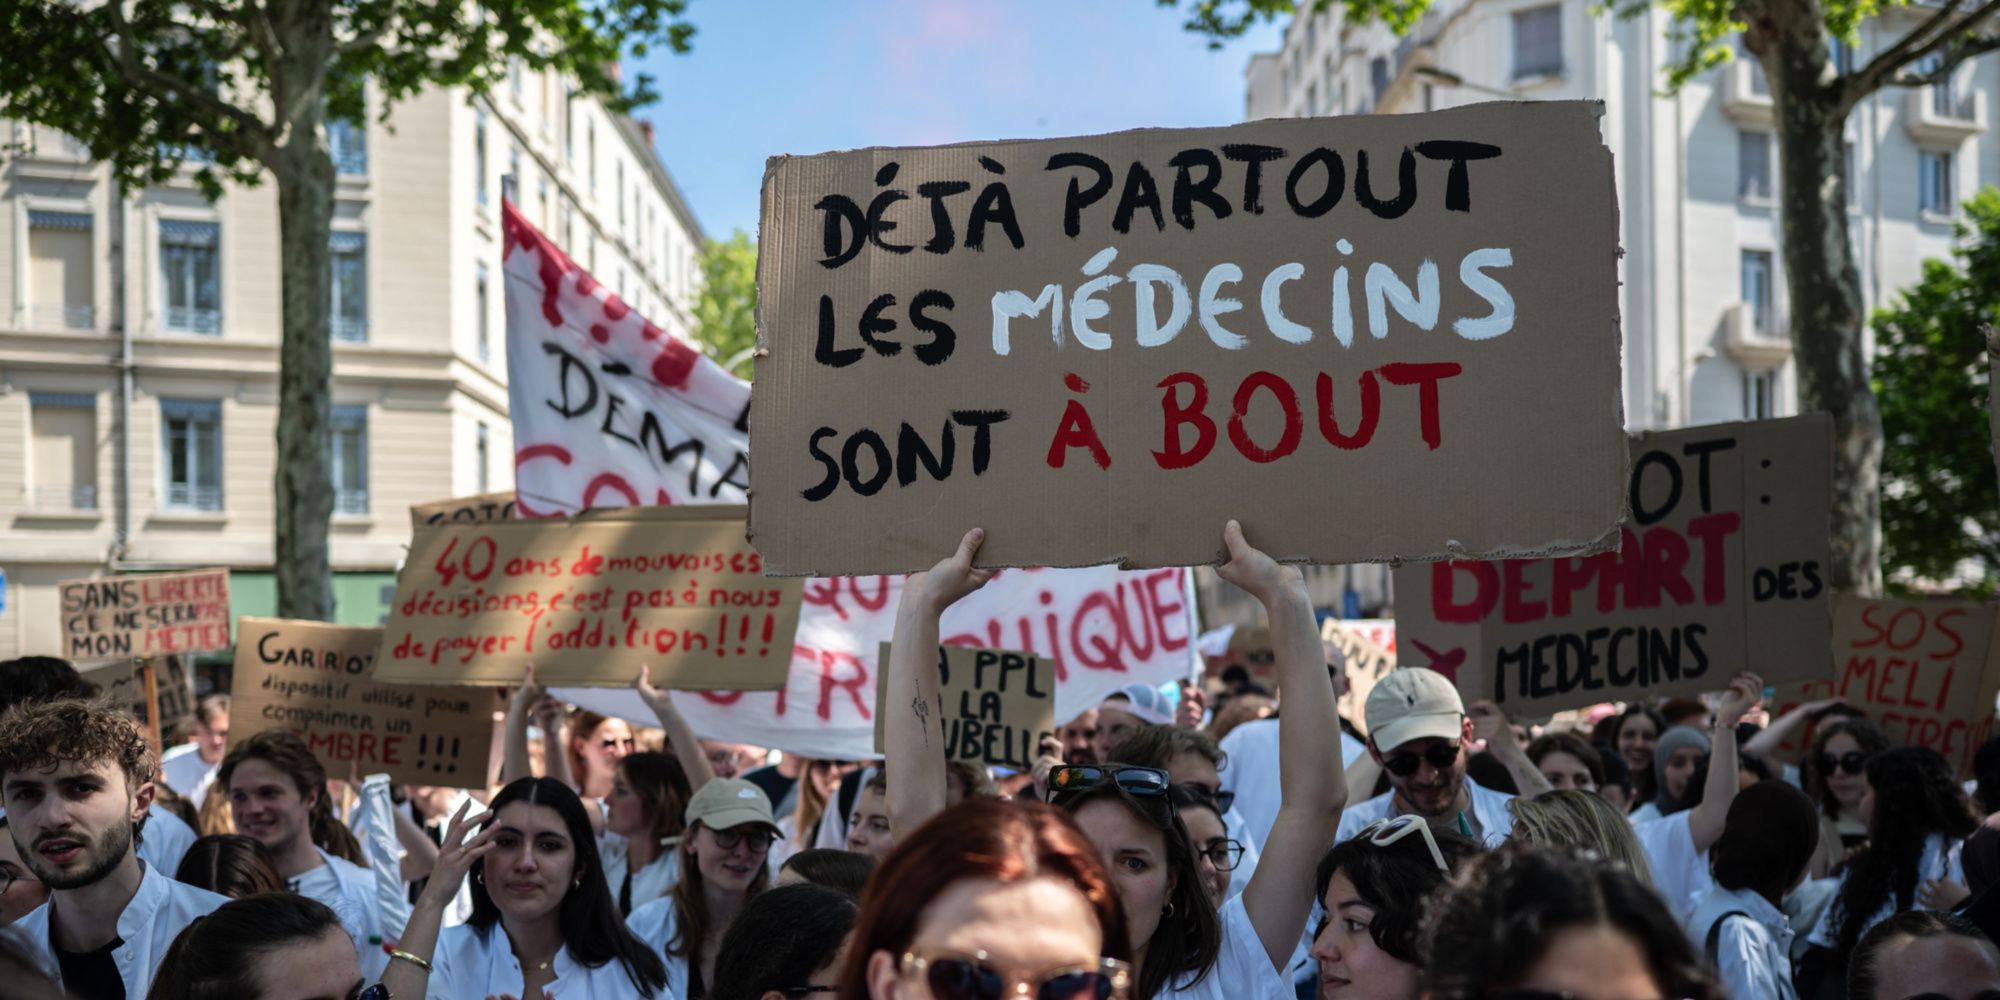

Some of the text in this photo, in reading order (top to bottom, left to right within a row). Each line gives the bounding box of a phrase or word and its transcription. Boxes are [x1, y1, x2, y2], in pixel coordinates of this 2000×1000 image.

[815, 140, 1502, 268] DÉJÀ PARTOUT
[815, 239, 1517, 368] LES MÉDECINS
[800, 409, 1010, 502] SONT
[1047, 371, 1111, 470] À
[1150, 362, 1462, 470] BOUT
[1631, 438, 1736, 525] OT
[435, 536, 497, 587] 40
[504, 558, 561, 577] ans
[571, 545, 604, 576] de
[1753, 560, 1822, 602] DES
[64, 580, 139, 612] SANS
[682, 579, 698, 604] à
[709, 588, 781, 607] nous
[69, 613, 100, 633] CE
[114, 609, 142, 630] NE
[1850, 604, 1968, 660] SOS
[72, 633, 131, 656] MON
[258, 632, 373, 675] GAR(R)O
[392, 631, 425, 660] de
[1494, 622, 1709, 704] MEDECINS
[262, 675, 350, 699] dispositif
[974, 651, 1047, 699] PPL
[960, 690, 1001, 723] LA
[294, 728, 404, 766] MBRE
